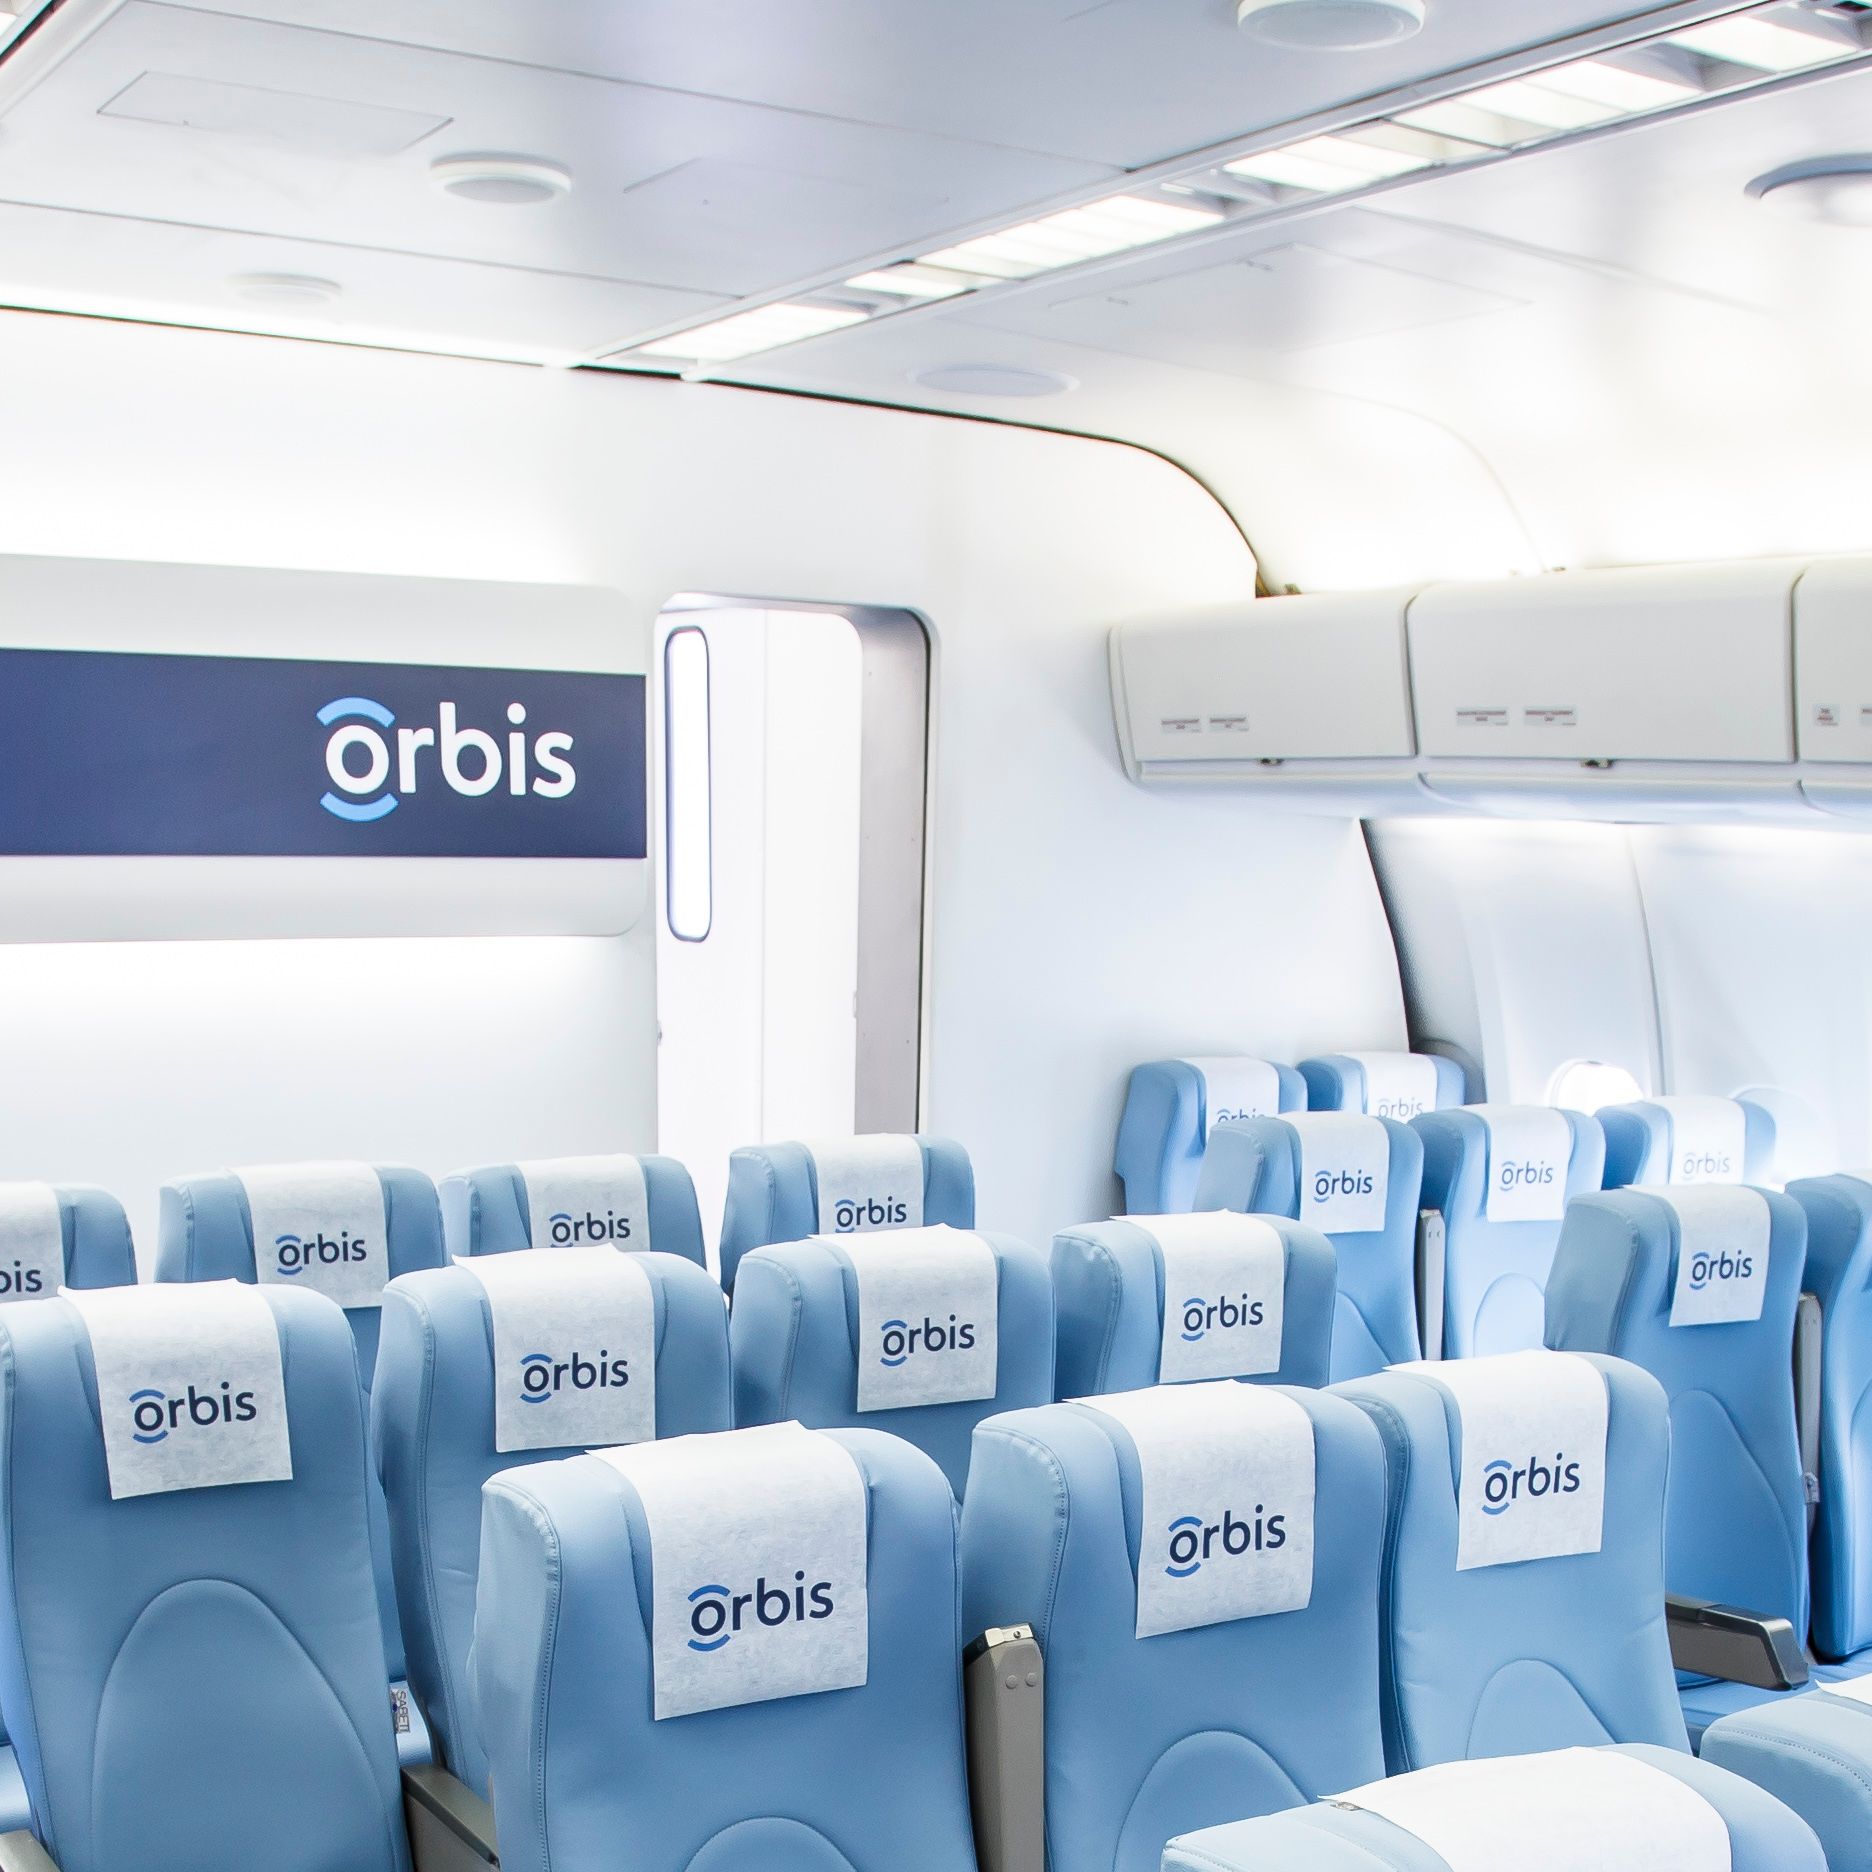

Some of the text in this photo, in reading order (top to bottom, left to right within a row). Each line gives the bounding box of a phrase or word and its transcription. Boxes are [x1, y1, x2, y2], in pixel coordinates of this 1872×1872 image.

[325, 701, 577, 798] orbis
[1316, 1170, 1372, 1195] orbis
[1501, 1160, 1553, 1185] orbis
[550, 1211, 630, 1243] orbis
[836, 1196, 906, 1230] orbis
[279, 1232, 366, 1268] orbis
[1691, 1250, 1752, 1282] orbis
[1184, 1294, 1263, 1331] orbis
[883, 1315, 974, 1355] orbis
[524, 1350, 628, 1391] orbis
[135, 1382, 256, 1431] orbis
[1486, 1453, 1579, 1502] orbis
[1170, 1505, 1285, 1563] orbis
[692, 1571, 833, 1636] orbis
